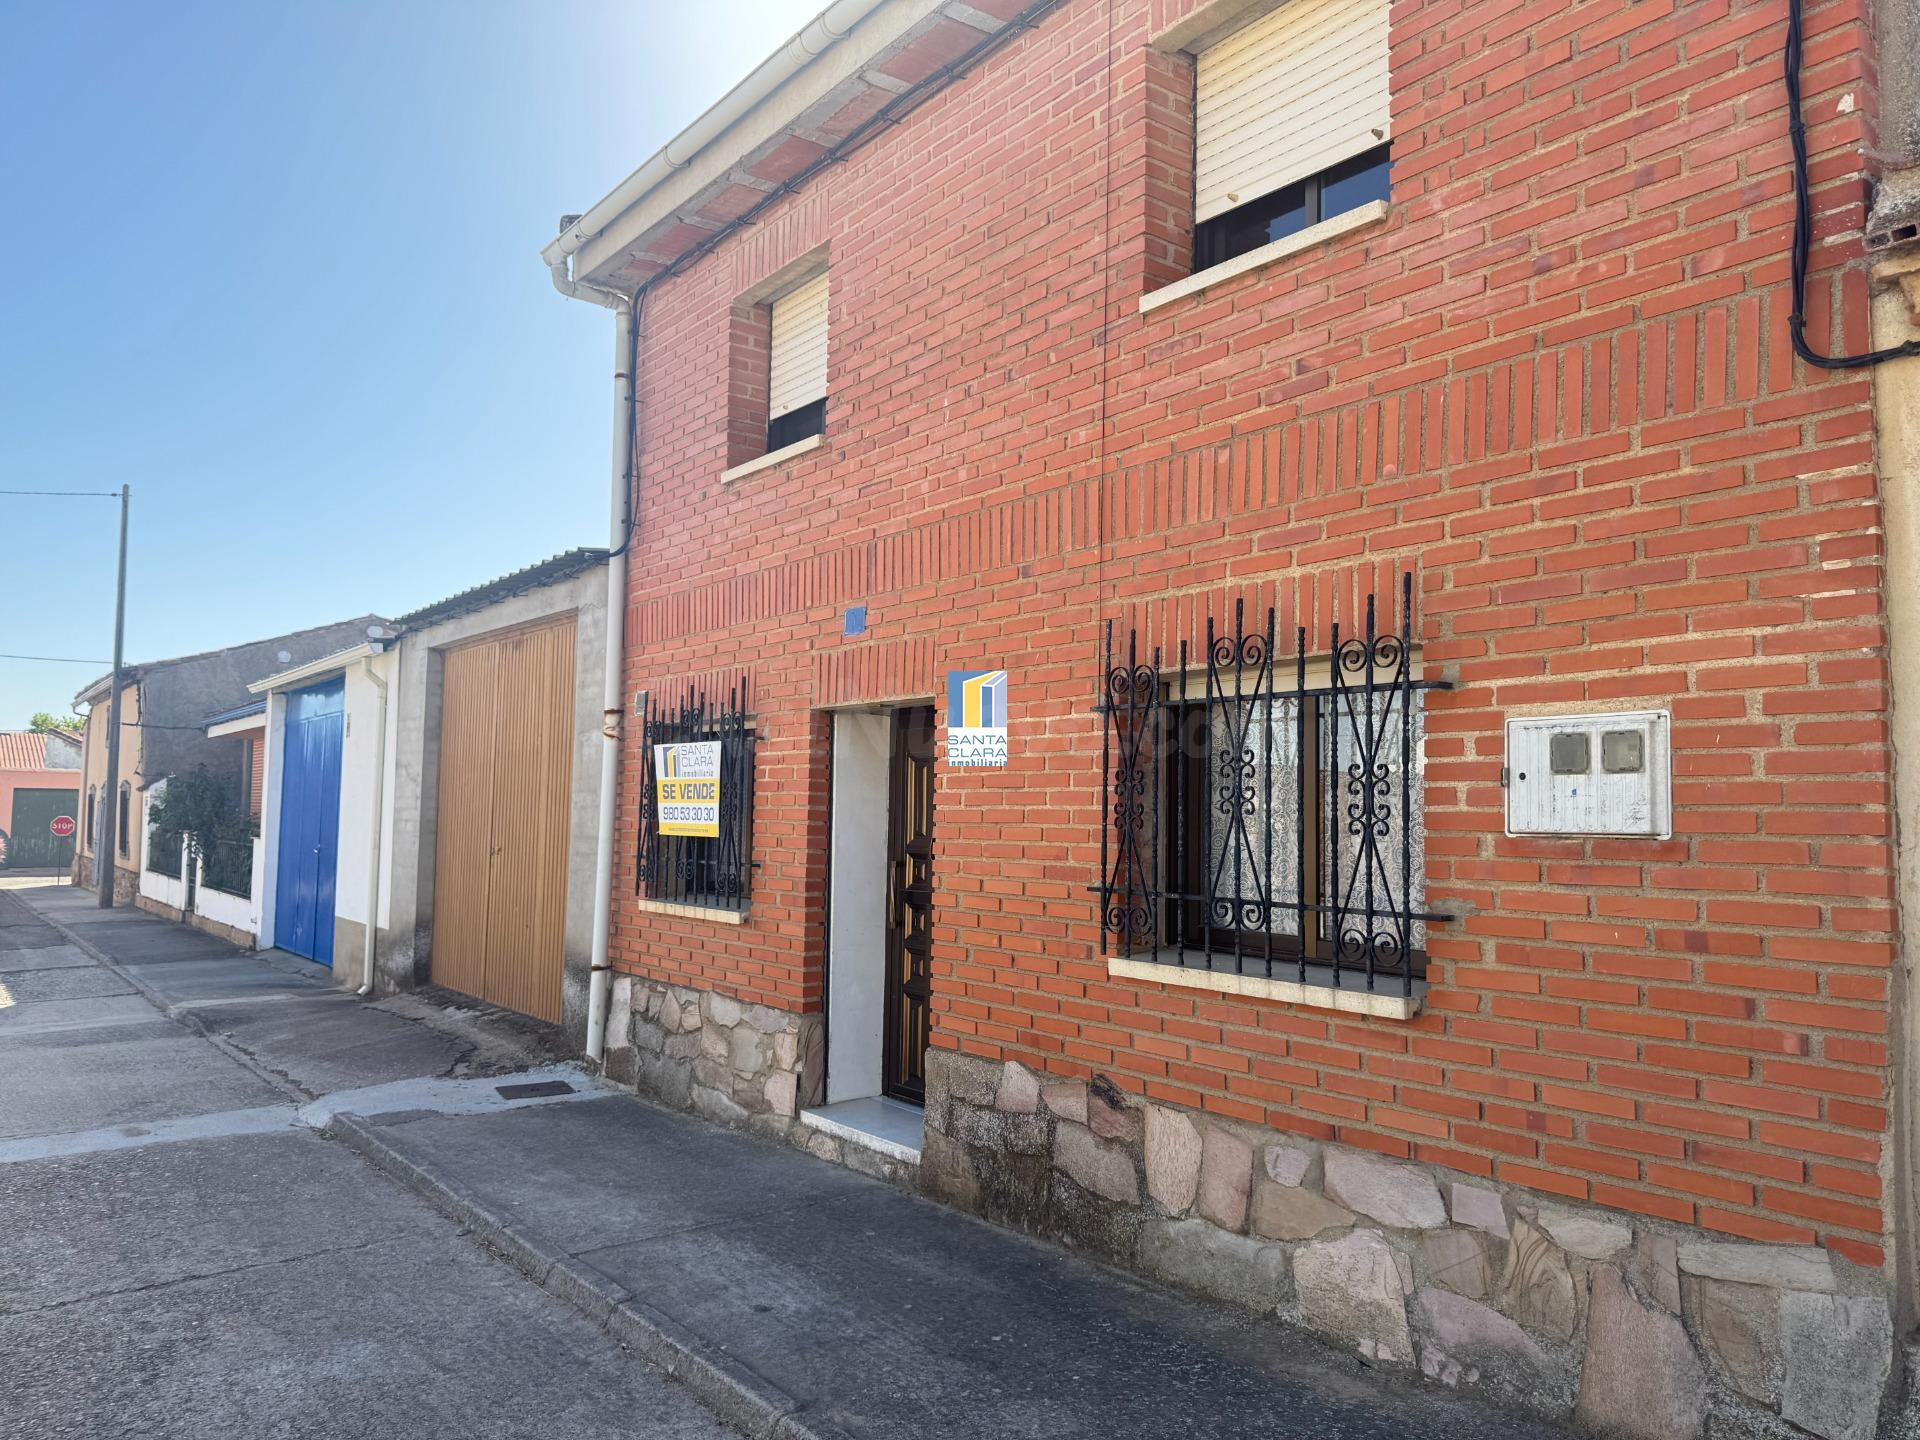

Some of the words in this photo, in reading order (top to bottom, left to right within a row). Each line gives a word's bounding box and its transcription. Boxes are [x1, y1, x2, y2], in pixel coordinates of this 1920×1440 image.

[681, 744, 713, 756] SANTA
[681, 756, 713, 767] CLARA
[662, 783, 676, 800] SE
[679, 783, 715, 800] VENDE
[663, 806, 679, 820] 980
[52, 822, 74, 830] STOP
